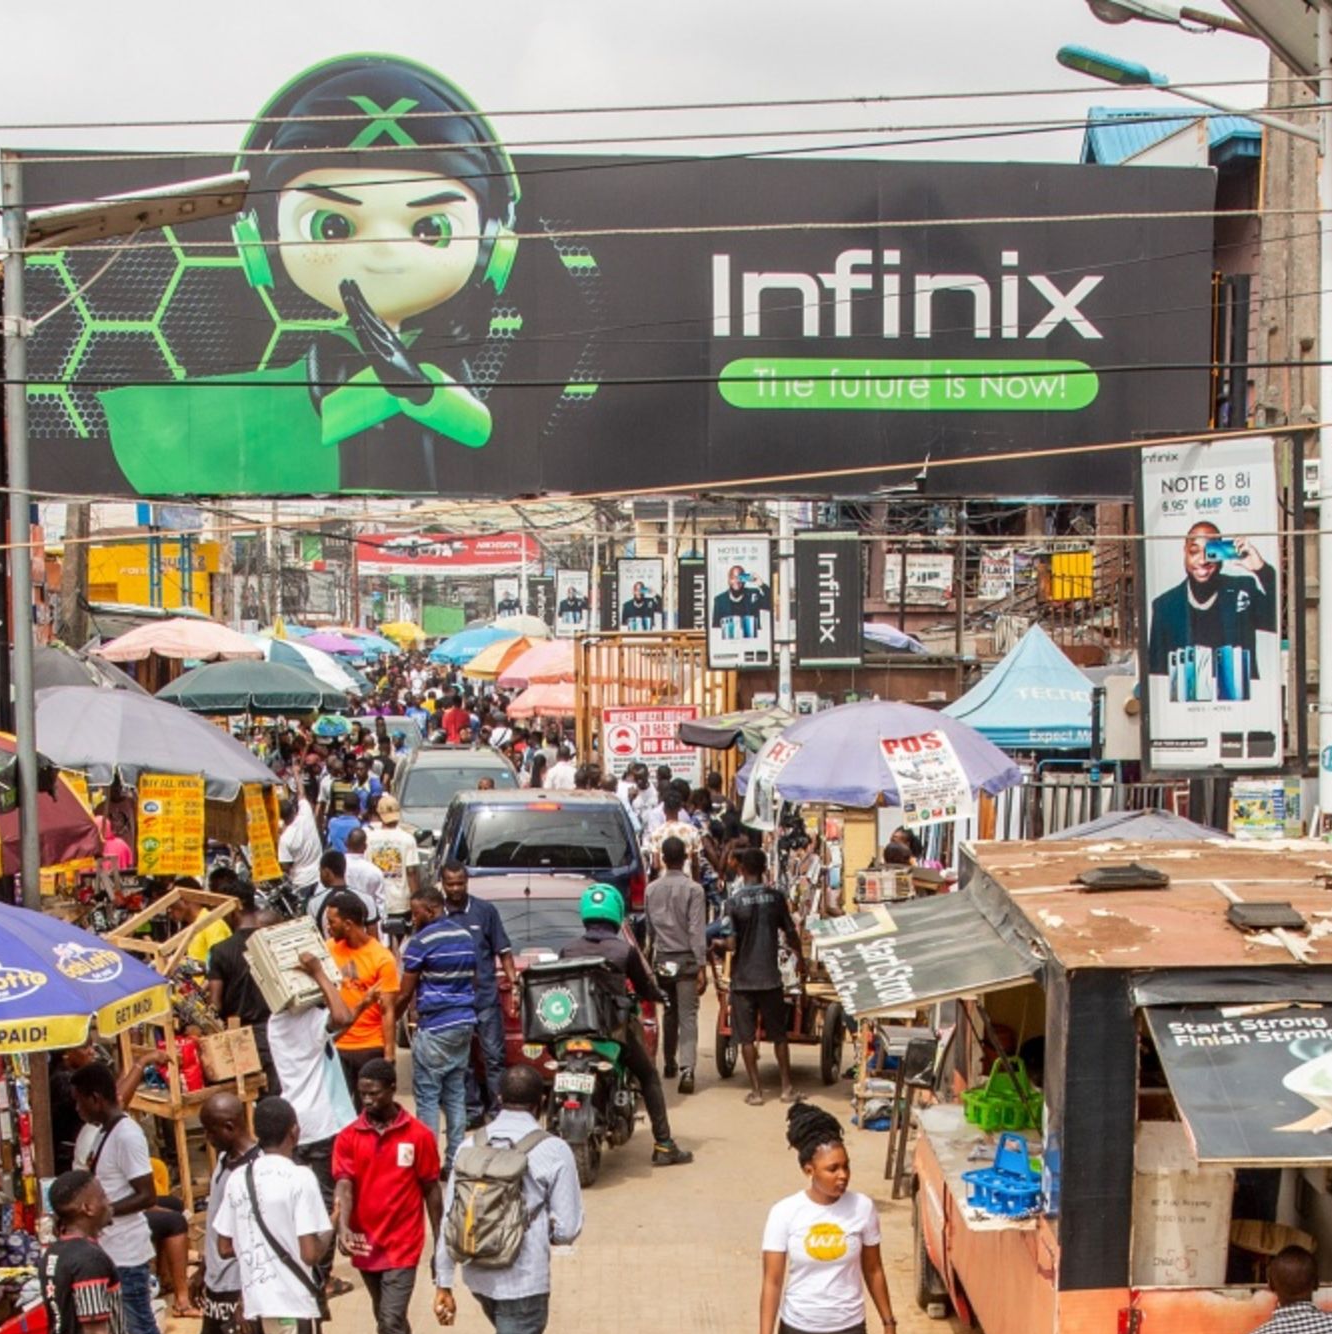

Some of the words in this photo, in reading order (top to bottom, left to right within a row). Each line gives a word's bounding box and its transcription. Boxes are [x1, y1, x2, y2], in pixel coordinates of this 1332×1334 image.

[711, 249, 1104, 339] Infinix
[752, 366, 814, 398] The
[829, 365, 929, 399] future
[945, 366, 966, 398] is
[980, 366, 1067, 398] Now!
[1162, 475, 1209, 494] NOTE
[1215, 473, 1226, 491] 8
[818, 552, 841, 644] Infinix
[882, 731, 943, 756] POS
[1169, 1020, 1235, 1036] Start
[1243, 1014, 1327, 1033] Strong
[1174, 1032, 1250, 1048] Finish
